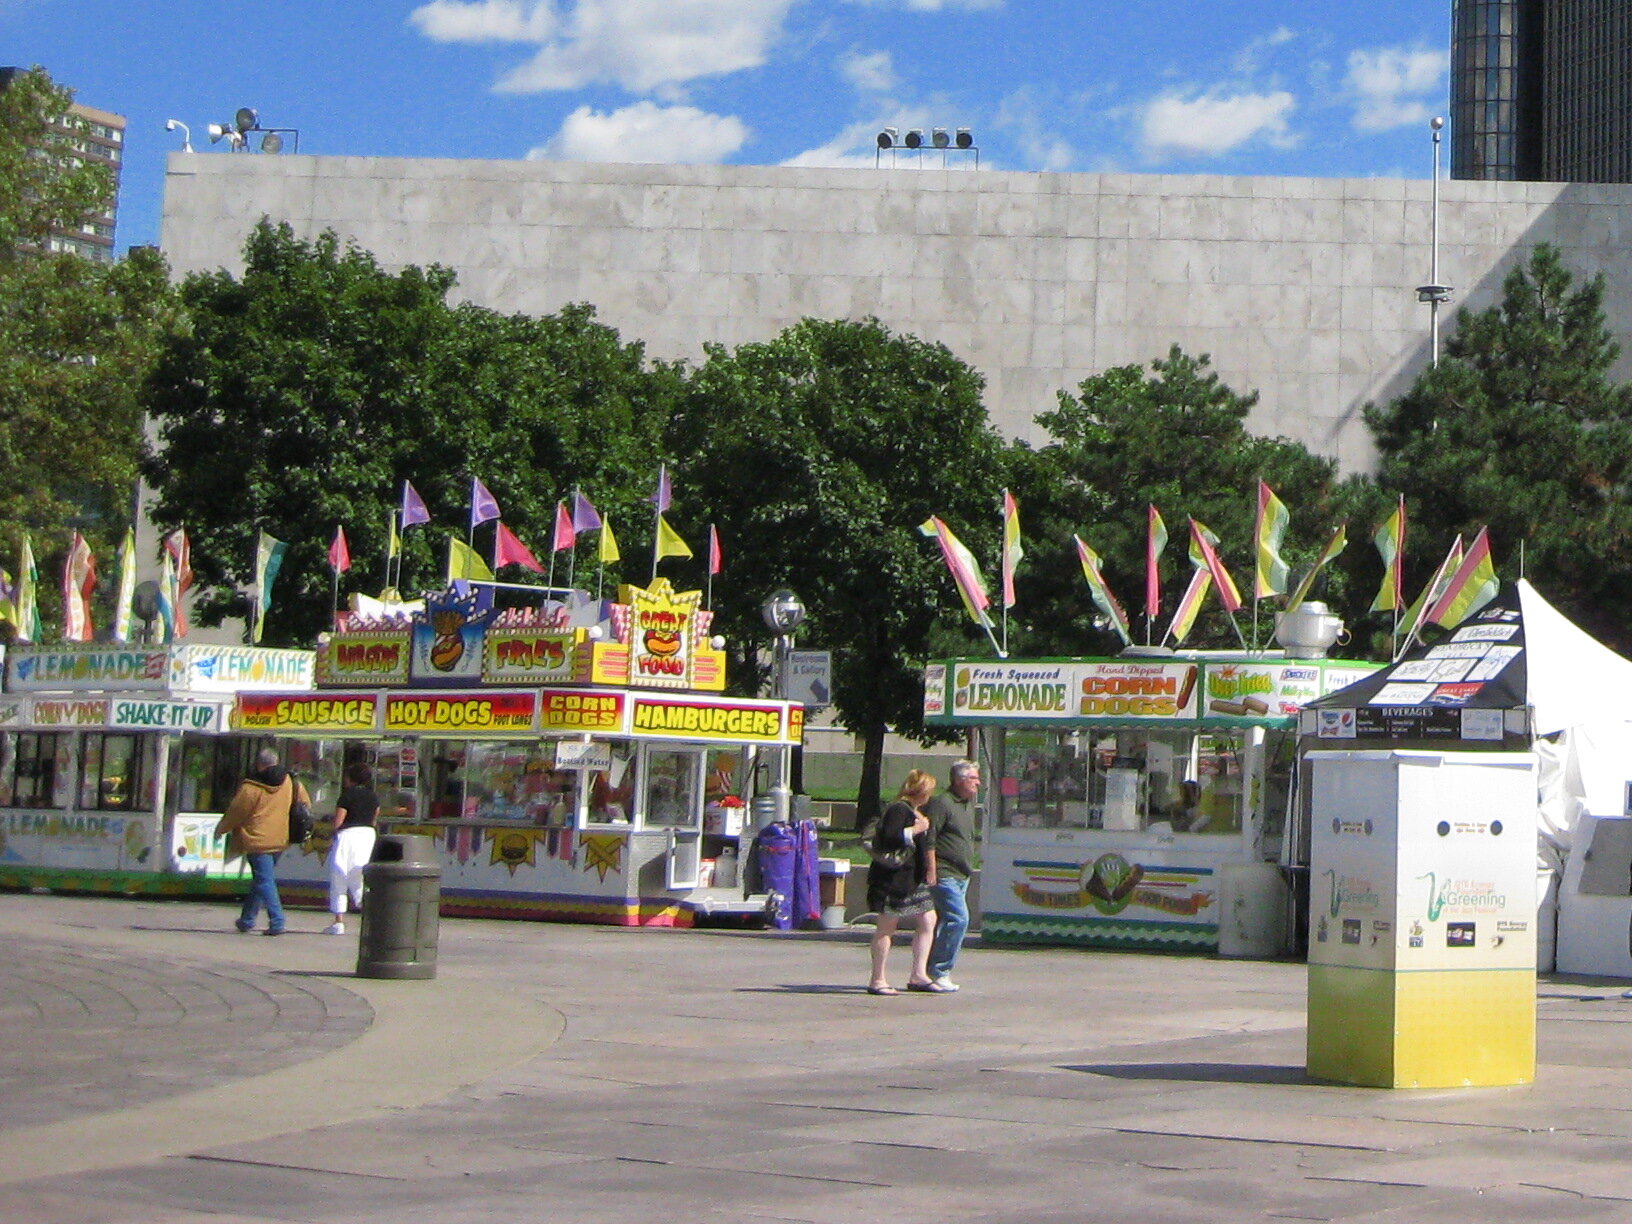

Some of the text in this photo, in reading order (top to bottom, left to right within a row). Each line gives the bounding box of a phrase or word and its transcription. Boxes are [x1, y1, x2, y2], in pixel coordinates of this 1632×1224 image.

[640, 610, 688, 630] GREAT
[496, 639, 566, 670] FRIES
[638, 655, 685, 676] FOOD
[1098, 664, 1164, 676] Hand Dipped
[972, 668, 1060, 683] Fresh Squeezed
[1082, 677, 1177, 695] CORN
[550, 695, 616, 711] CORN
[968, 682, 1066, 712] LEMONADE
[1080, 697, 1177, 716] DOGS
[276, 699, 374, 726] SAUSAGE
[390, 700, 430, 724] HOT
[434, 700, 492, 726] DOGS
[550, 711, 616, 727] DOGS
[635, 703, 780, 736] HAMBURGERS
[1382, 707, 1434, 717] BEVERAGES
[1447, 891, 1506, 908] Greening
